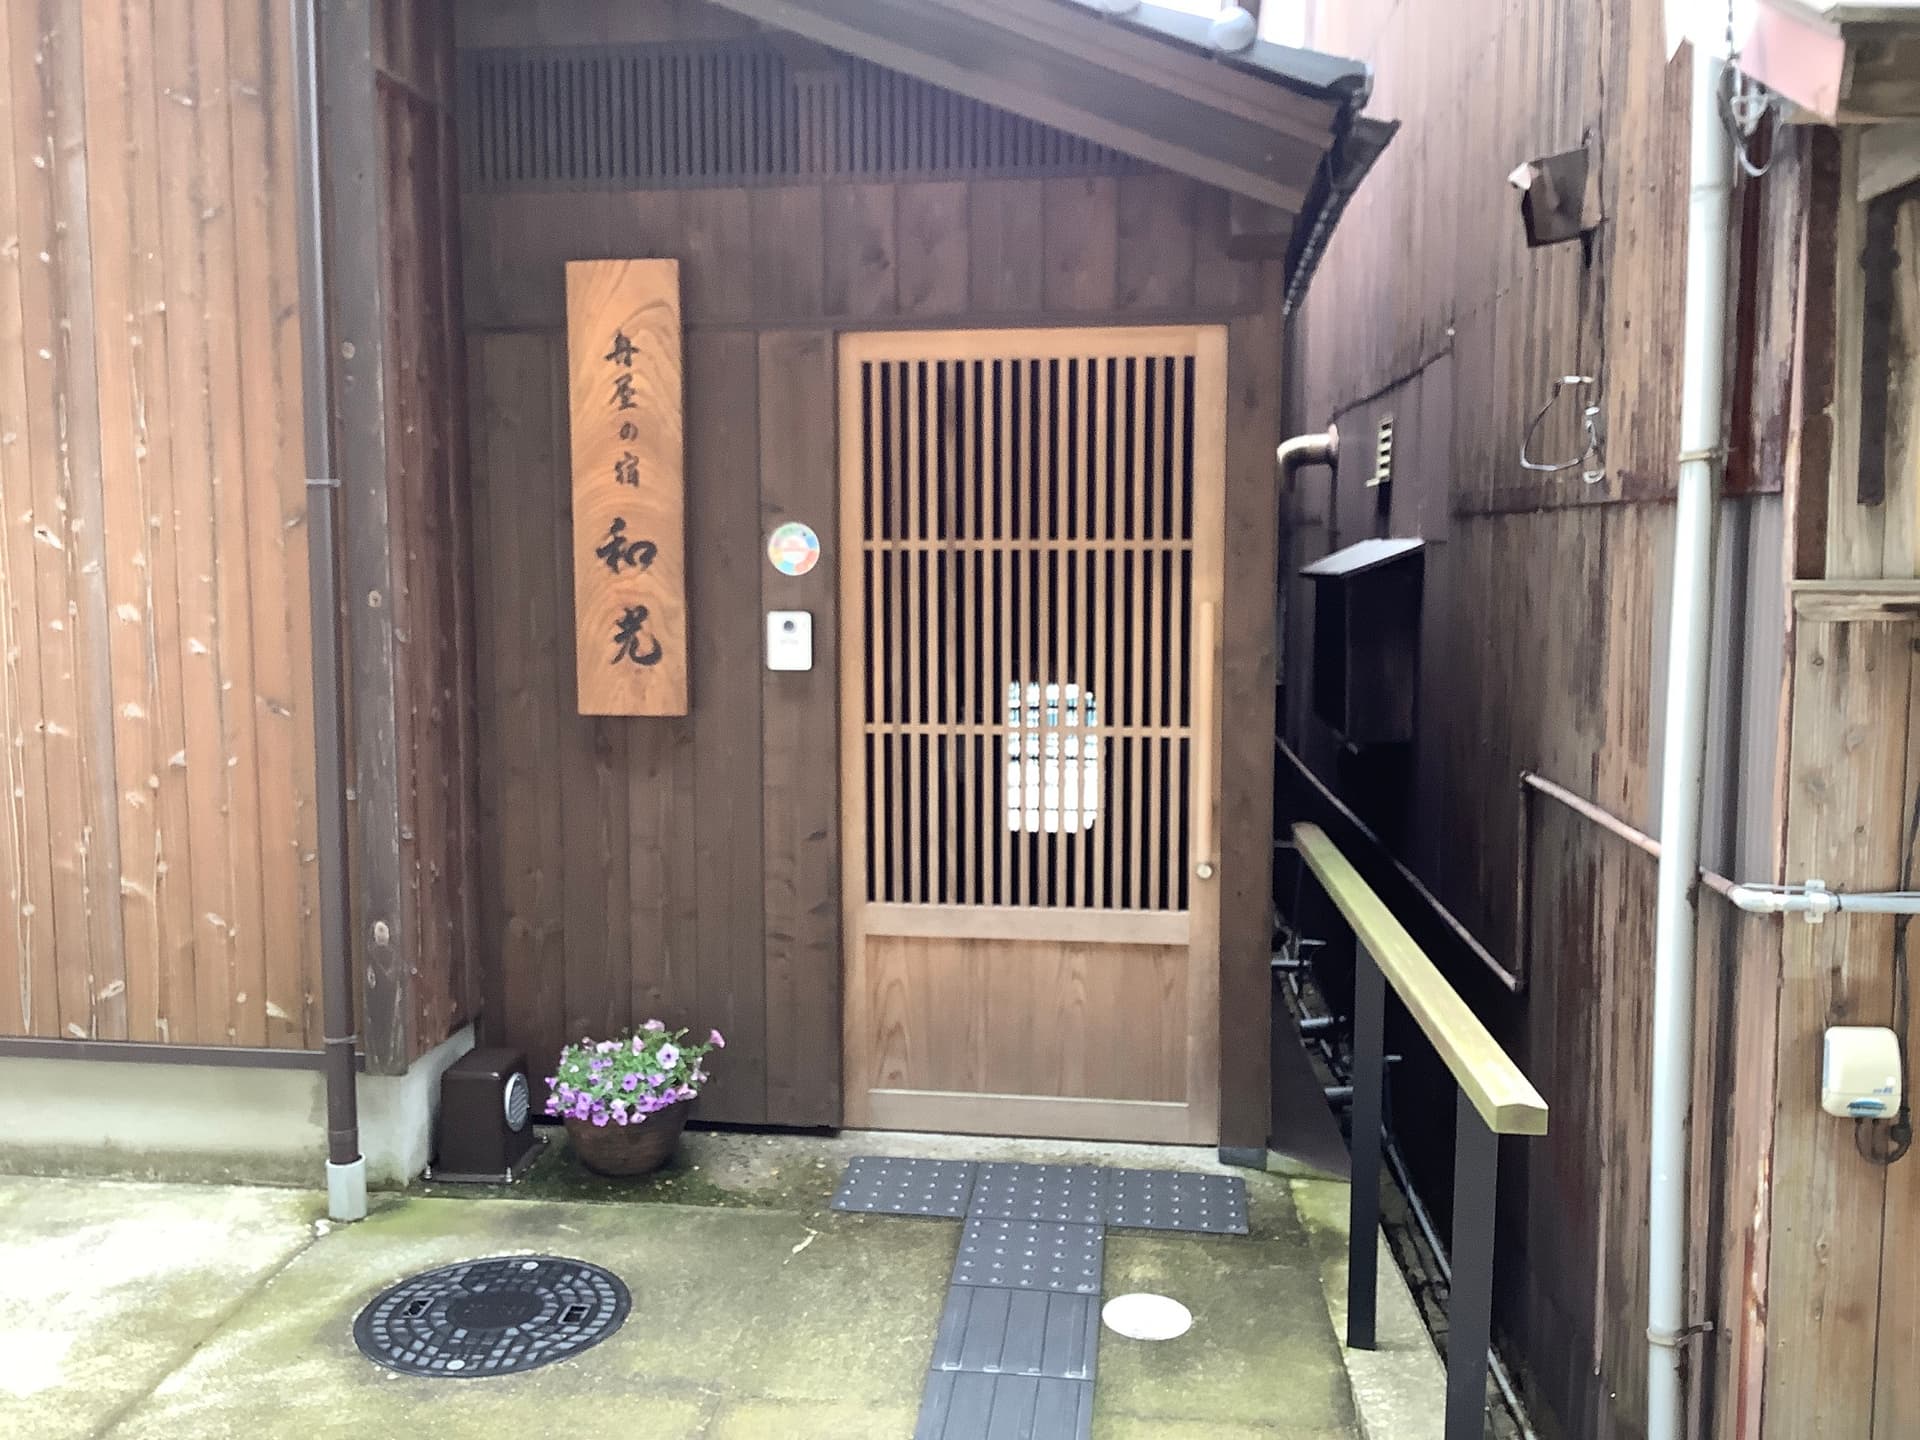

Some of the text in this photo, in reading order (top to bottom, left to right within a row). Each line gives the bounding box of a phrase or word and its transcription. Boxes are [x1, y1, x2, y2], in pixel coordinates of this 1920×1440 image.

[596, 330, 663, 666] 舟屋の宿 和光
